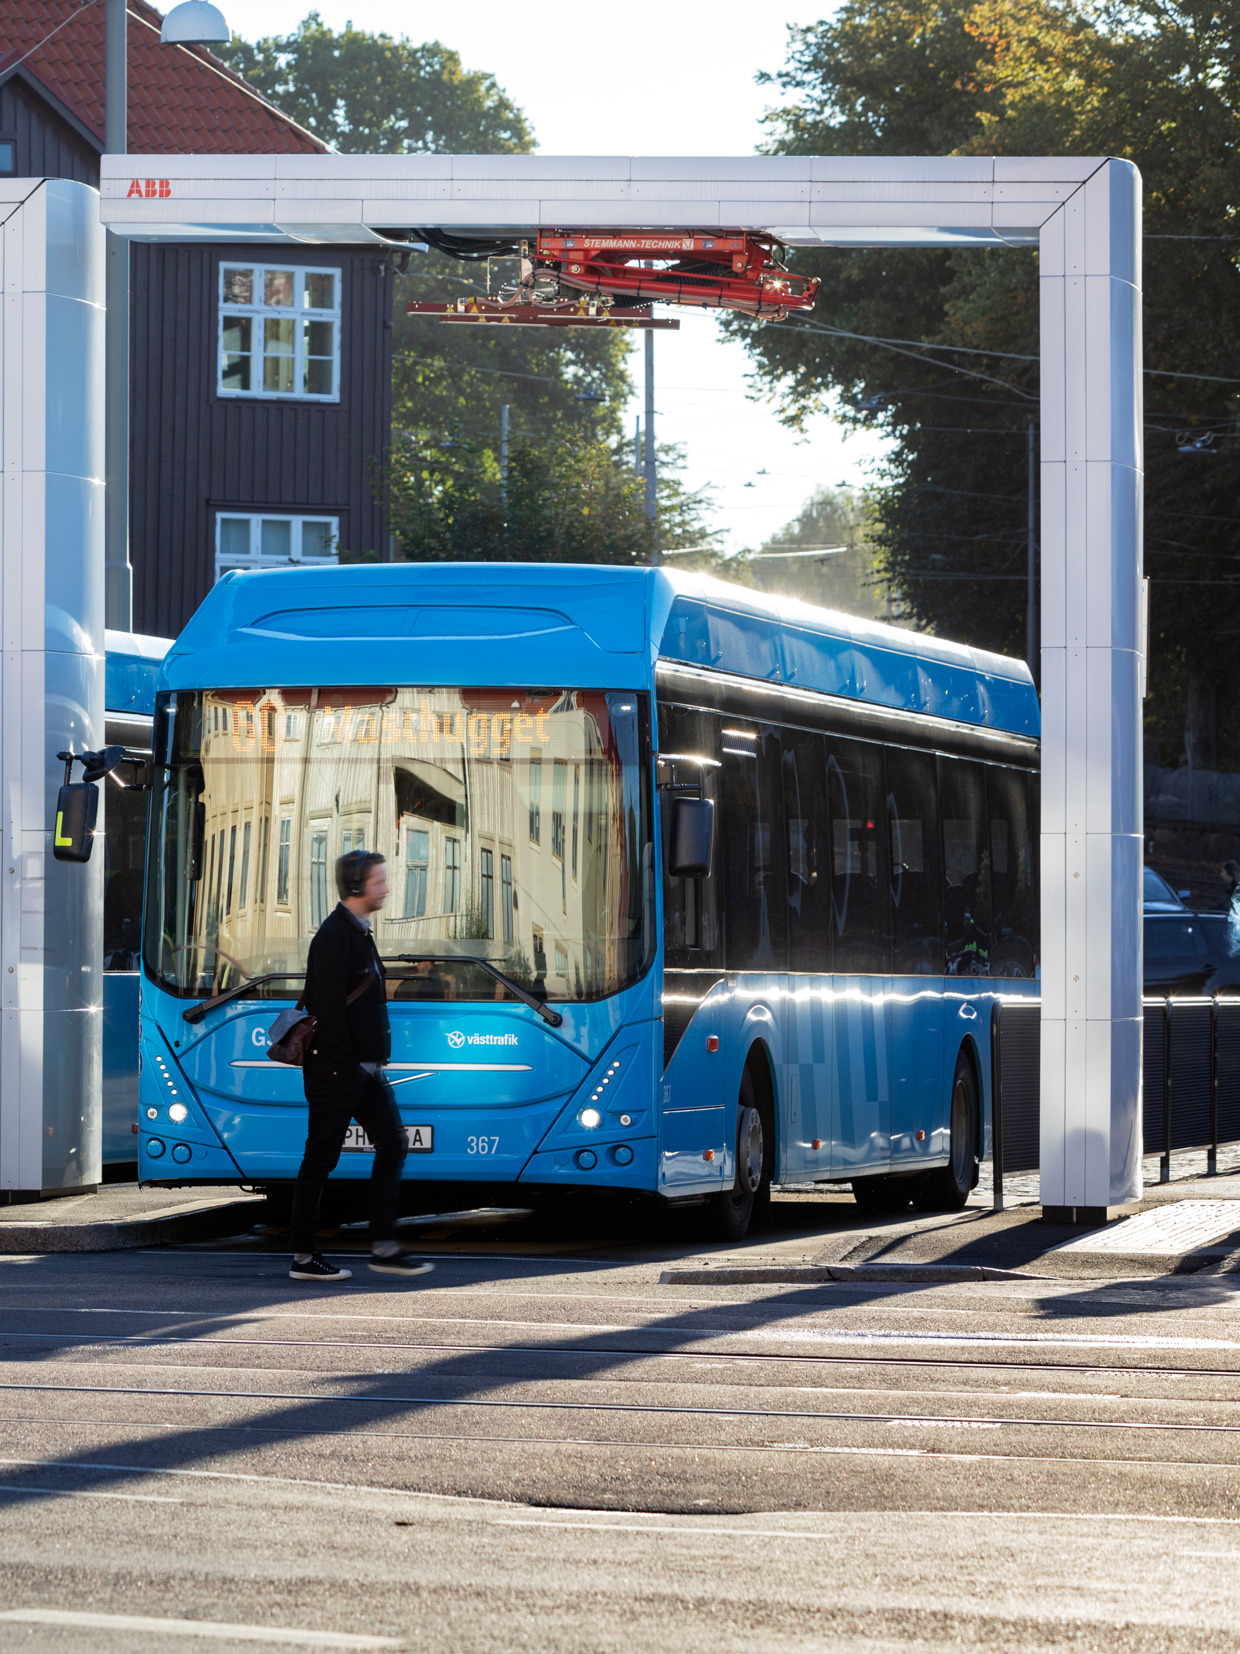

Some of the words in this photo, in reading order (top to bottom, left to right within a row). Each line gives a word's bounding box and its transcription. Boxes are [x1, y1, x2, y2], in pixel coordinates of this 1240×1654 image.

[126, 178, 171, 198] ABB
[583, 238, 682, 249] STEMMANN-TECHNIK
[232, 700, 284, 752] 60
[323, 699, 551, 755] Masthugget
[467, 1033, 519, 1046] västtrafik
[467, 1136, 500, 1155] 367
